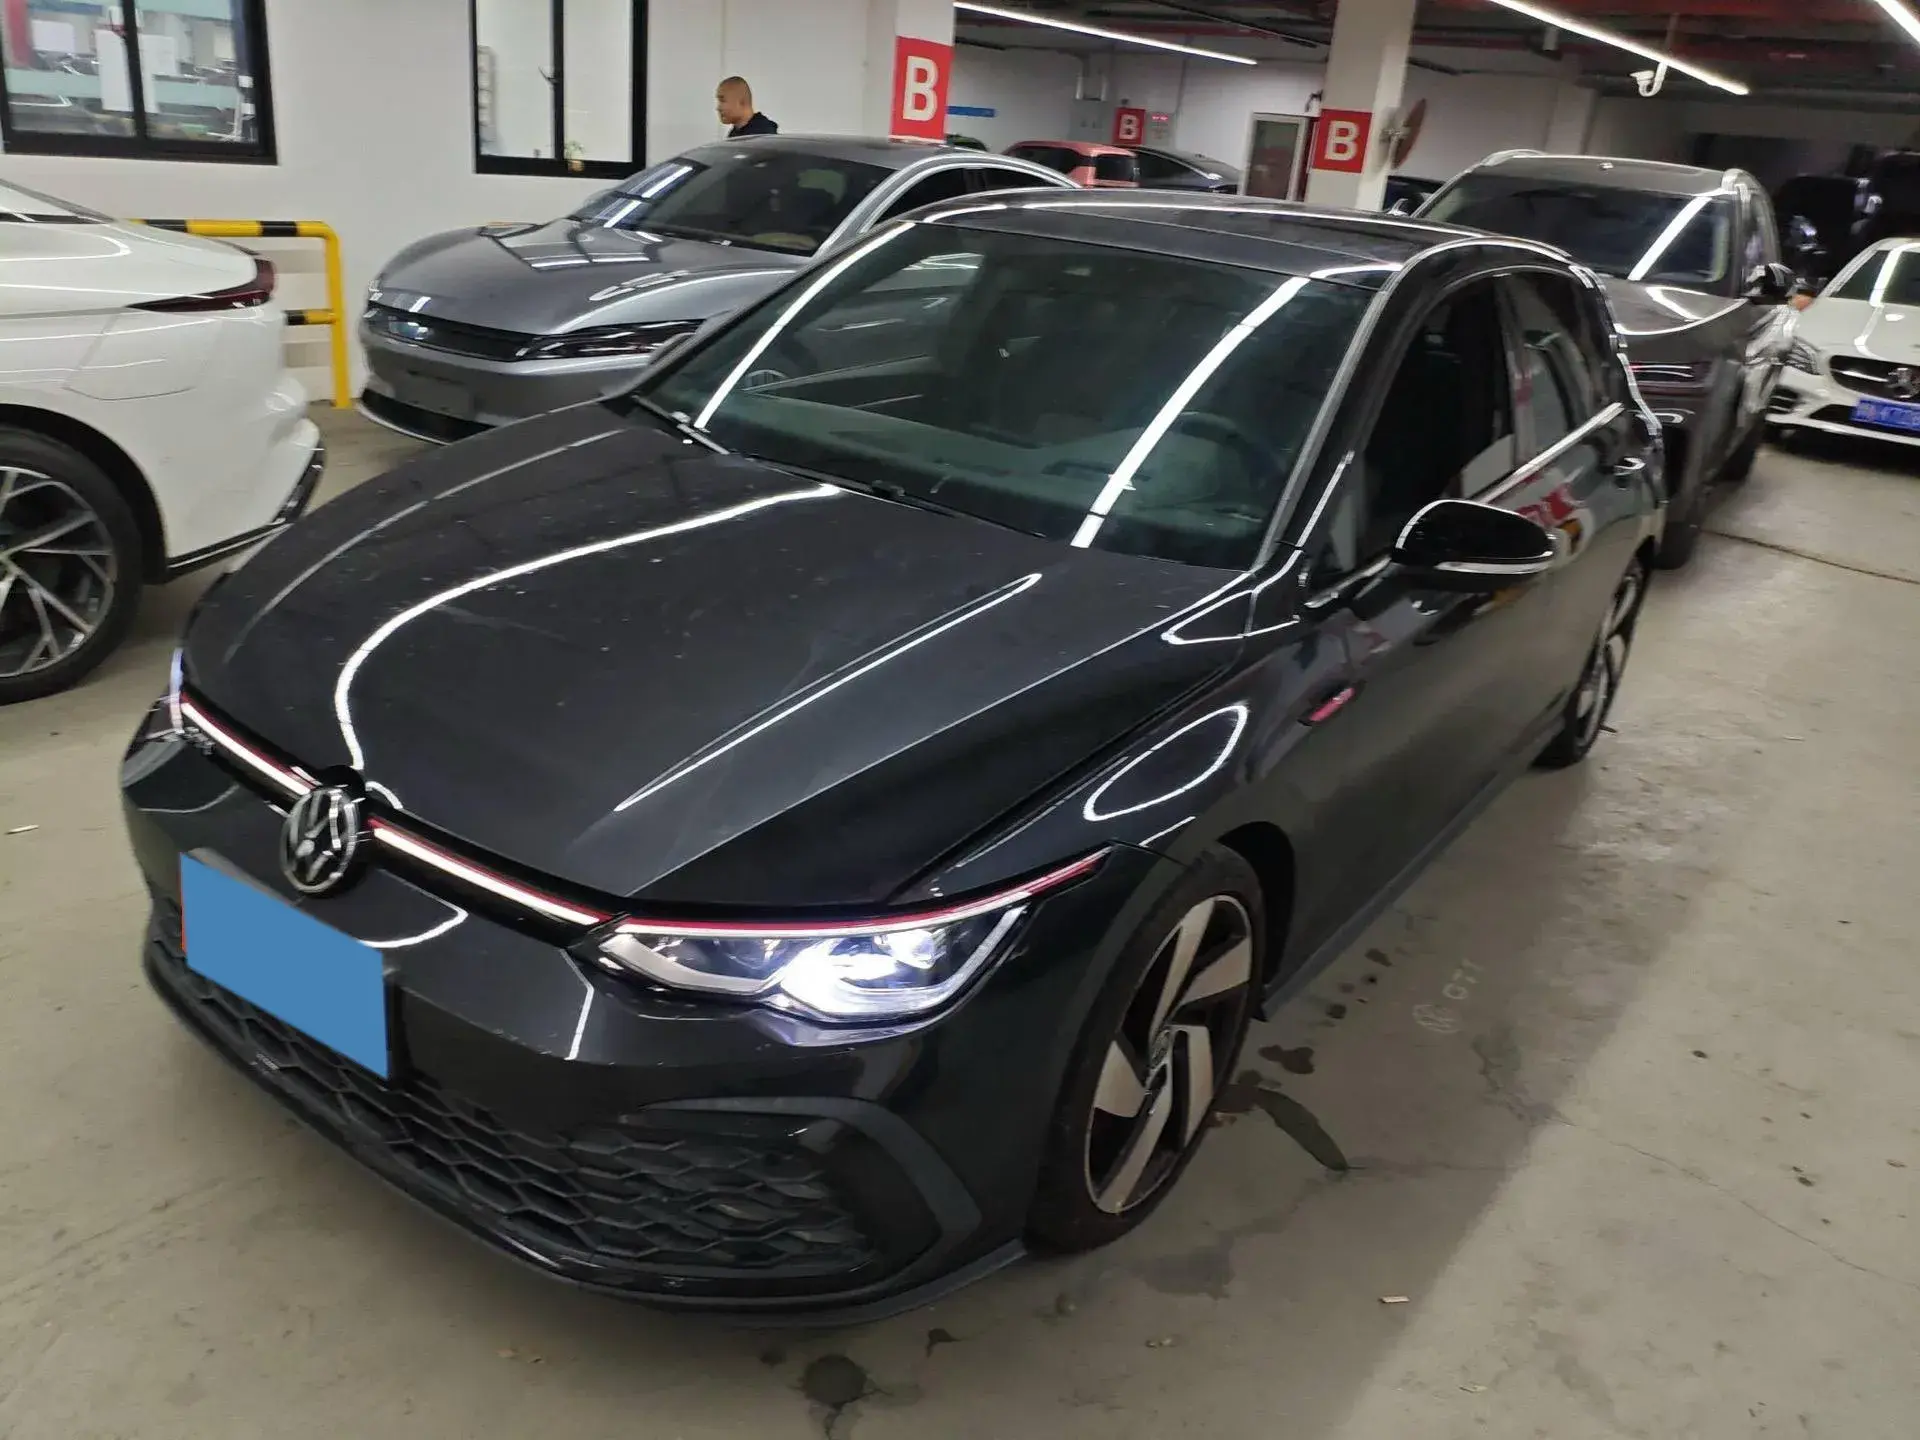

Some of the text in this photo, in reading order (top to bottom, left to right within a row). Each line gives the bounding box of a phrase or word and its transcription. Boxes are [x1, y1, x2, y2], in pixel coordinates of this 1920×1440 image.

[902, 55, 939, 121] B
[1119, 114, 1138, 140] B
[1324, 120, 1359, 161] B
